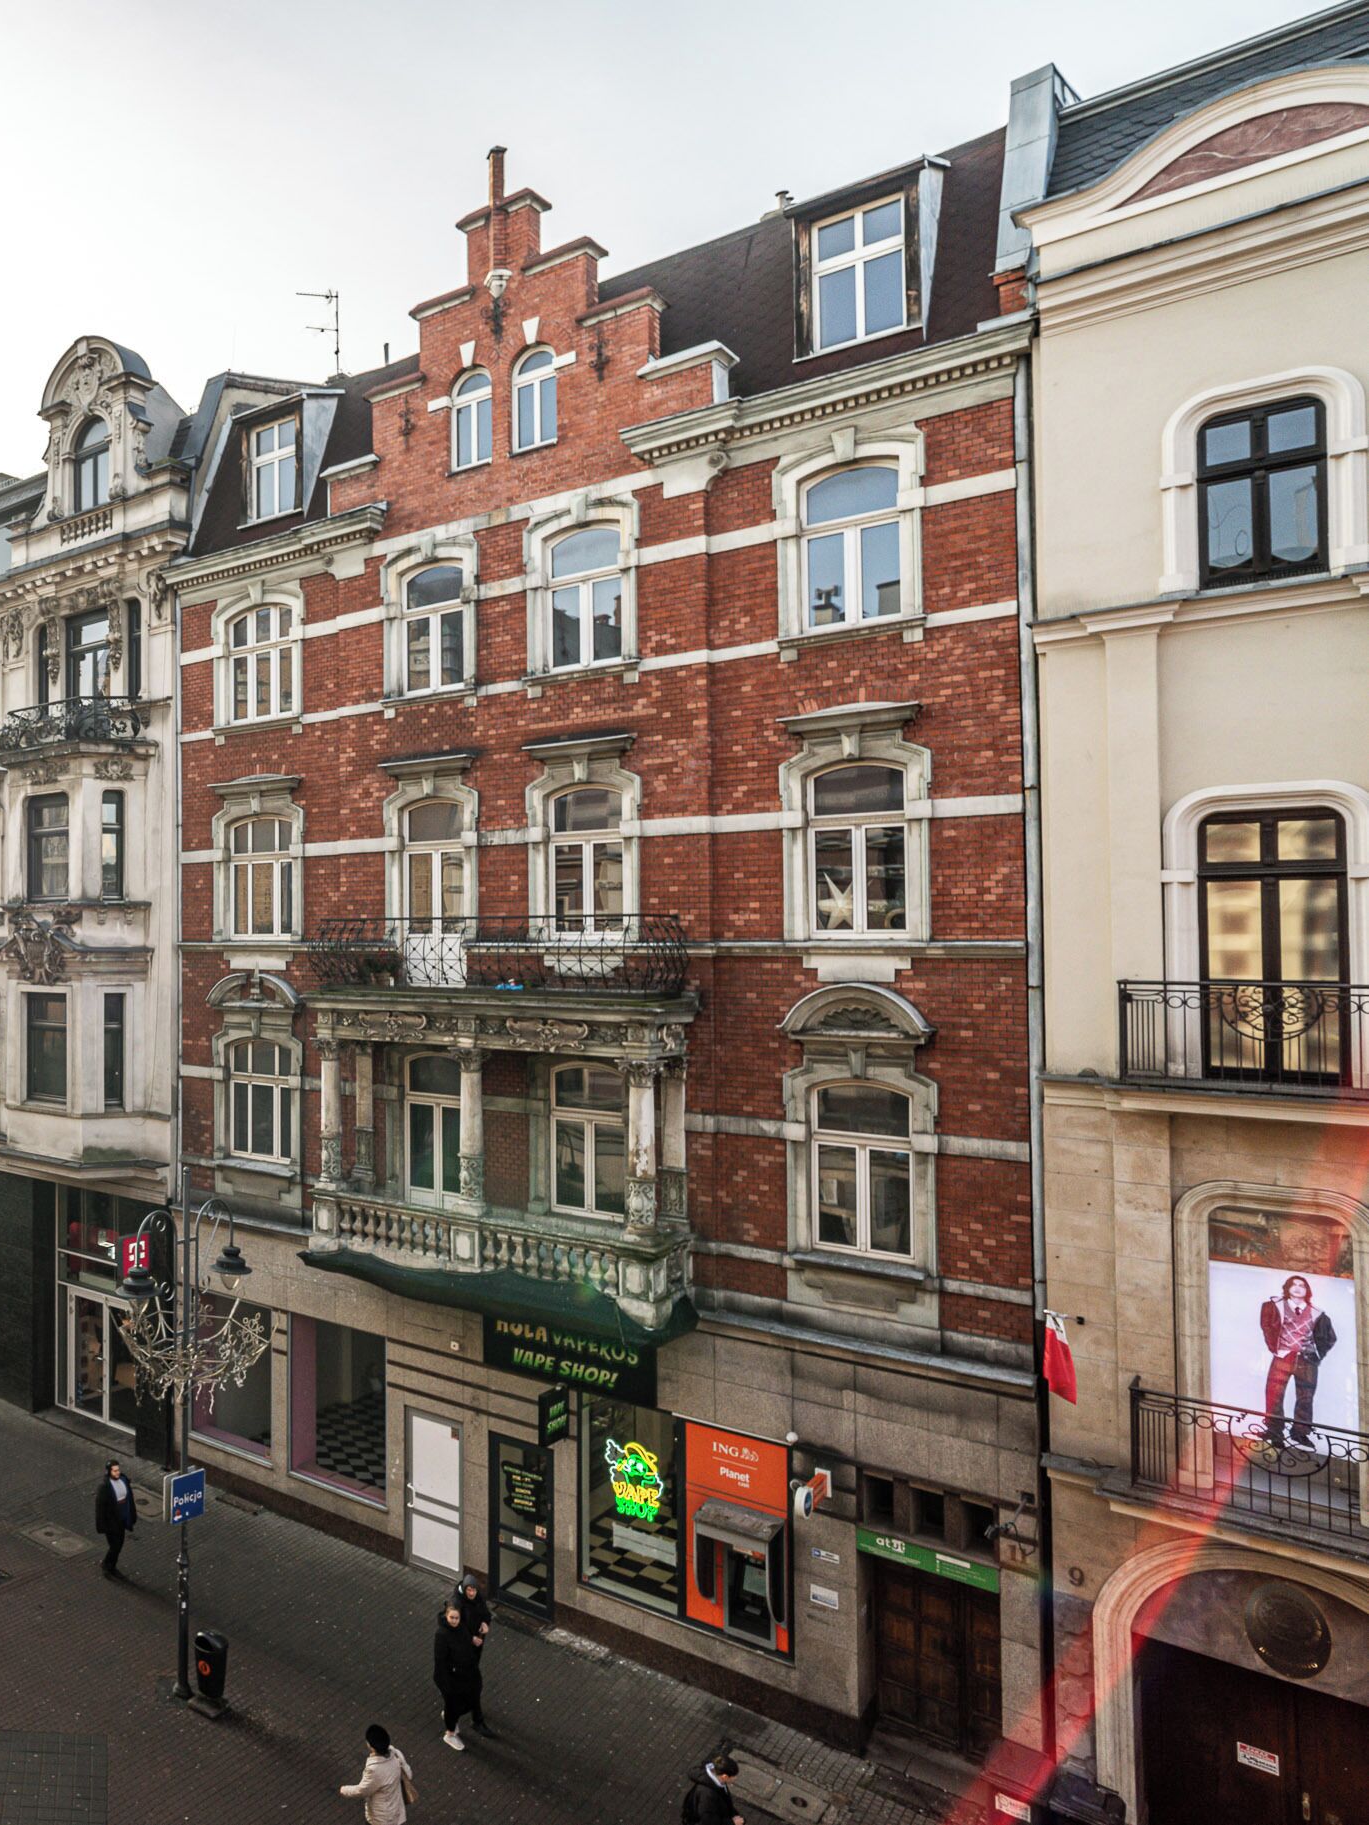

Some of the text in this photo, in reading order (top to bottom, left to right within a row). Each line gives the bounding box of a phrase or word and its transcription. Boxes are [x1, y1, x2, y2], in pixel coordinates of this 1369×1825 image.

[513, 1347, 619, 1388] VAPE SHOP!
[712, 1441, 739, 1458] ING
[719, 1466, 751, 1482] Planet
[173, 1490, 203, 1508] Policja
[613, 1481, 661, 1508] VAPE
[615, 1496, 659, 1523] SHOP
[1068, 1566, 1085, 1587] 9
